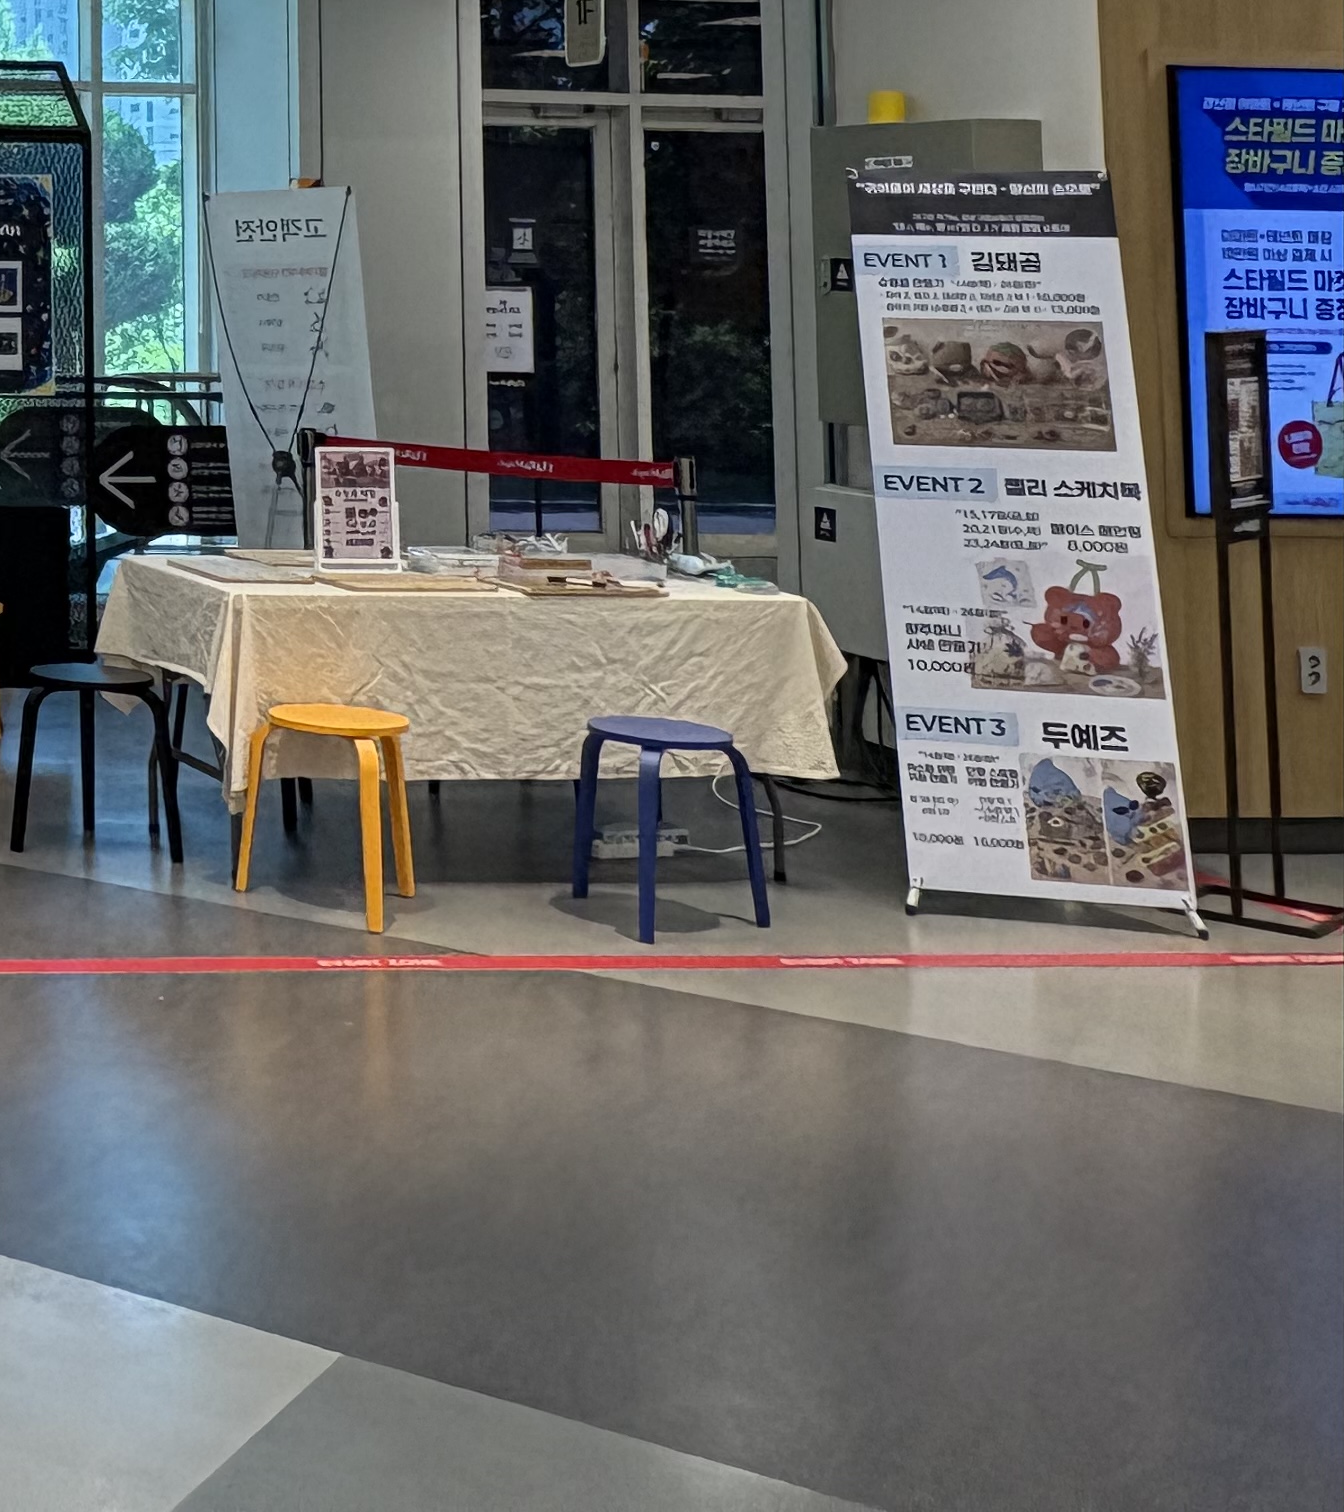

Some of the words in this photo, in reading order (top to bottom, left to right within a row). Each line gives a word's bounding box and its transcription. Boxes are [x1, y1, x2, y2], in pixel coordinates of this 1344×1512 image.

[1224, 117, 1316, 143] 스타필드
[1225, 148, 1316, 175] 장바구니
[863, 252, 933, 268] EVENT
[1320, 248, 1332, 262] 시
[1223, 268, 1309, 292] 스타필드
[1224, 297, 1308, 320] 장바구니
[883, 474, 965, 493] EVENT
[969, 478, 986, 494] 2
[1053, 480, 1142, 501] 스케치북
[906, 714, 986, 735] EVENT
[991, 719, 1006, 736] 3
[1042, 722, 1129, 751] 두예즈
